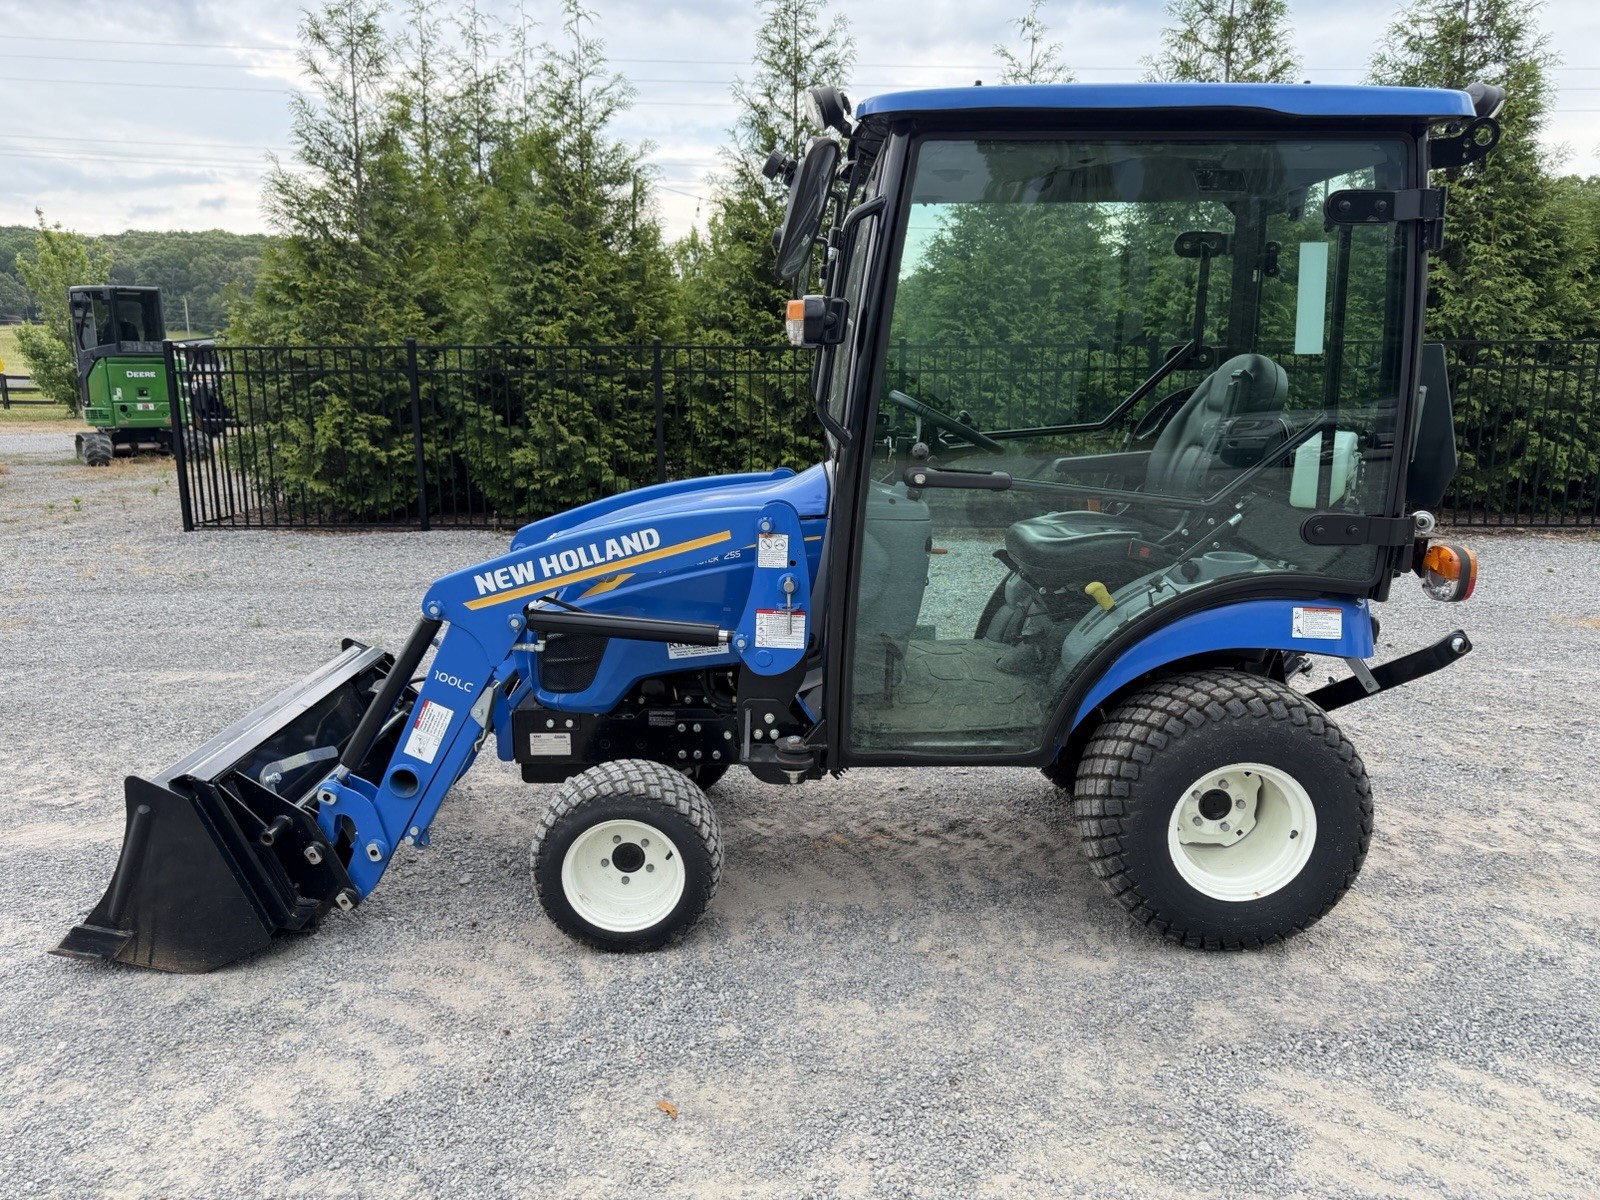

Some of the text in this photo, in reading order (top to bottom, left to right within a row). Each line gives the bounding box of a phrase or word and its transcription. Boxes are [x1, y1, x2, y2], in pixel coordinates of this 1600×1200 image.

[126, 370, 156, 378] DEERE
[473, 561, 535, 595] NEW
[539, 528, 661, 577] HOLLAND
[434, 670, 474, 693] 100LC
